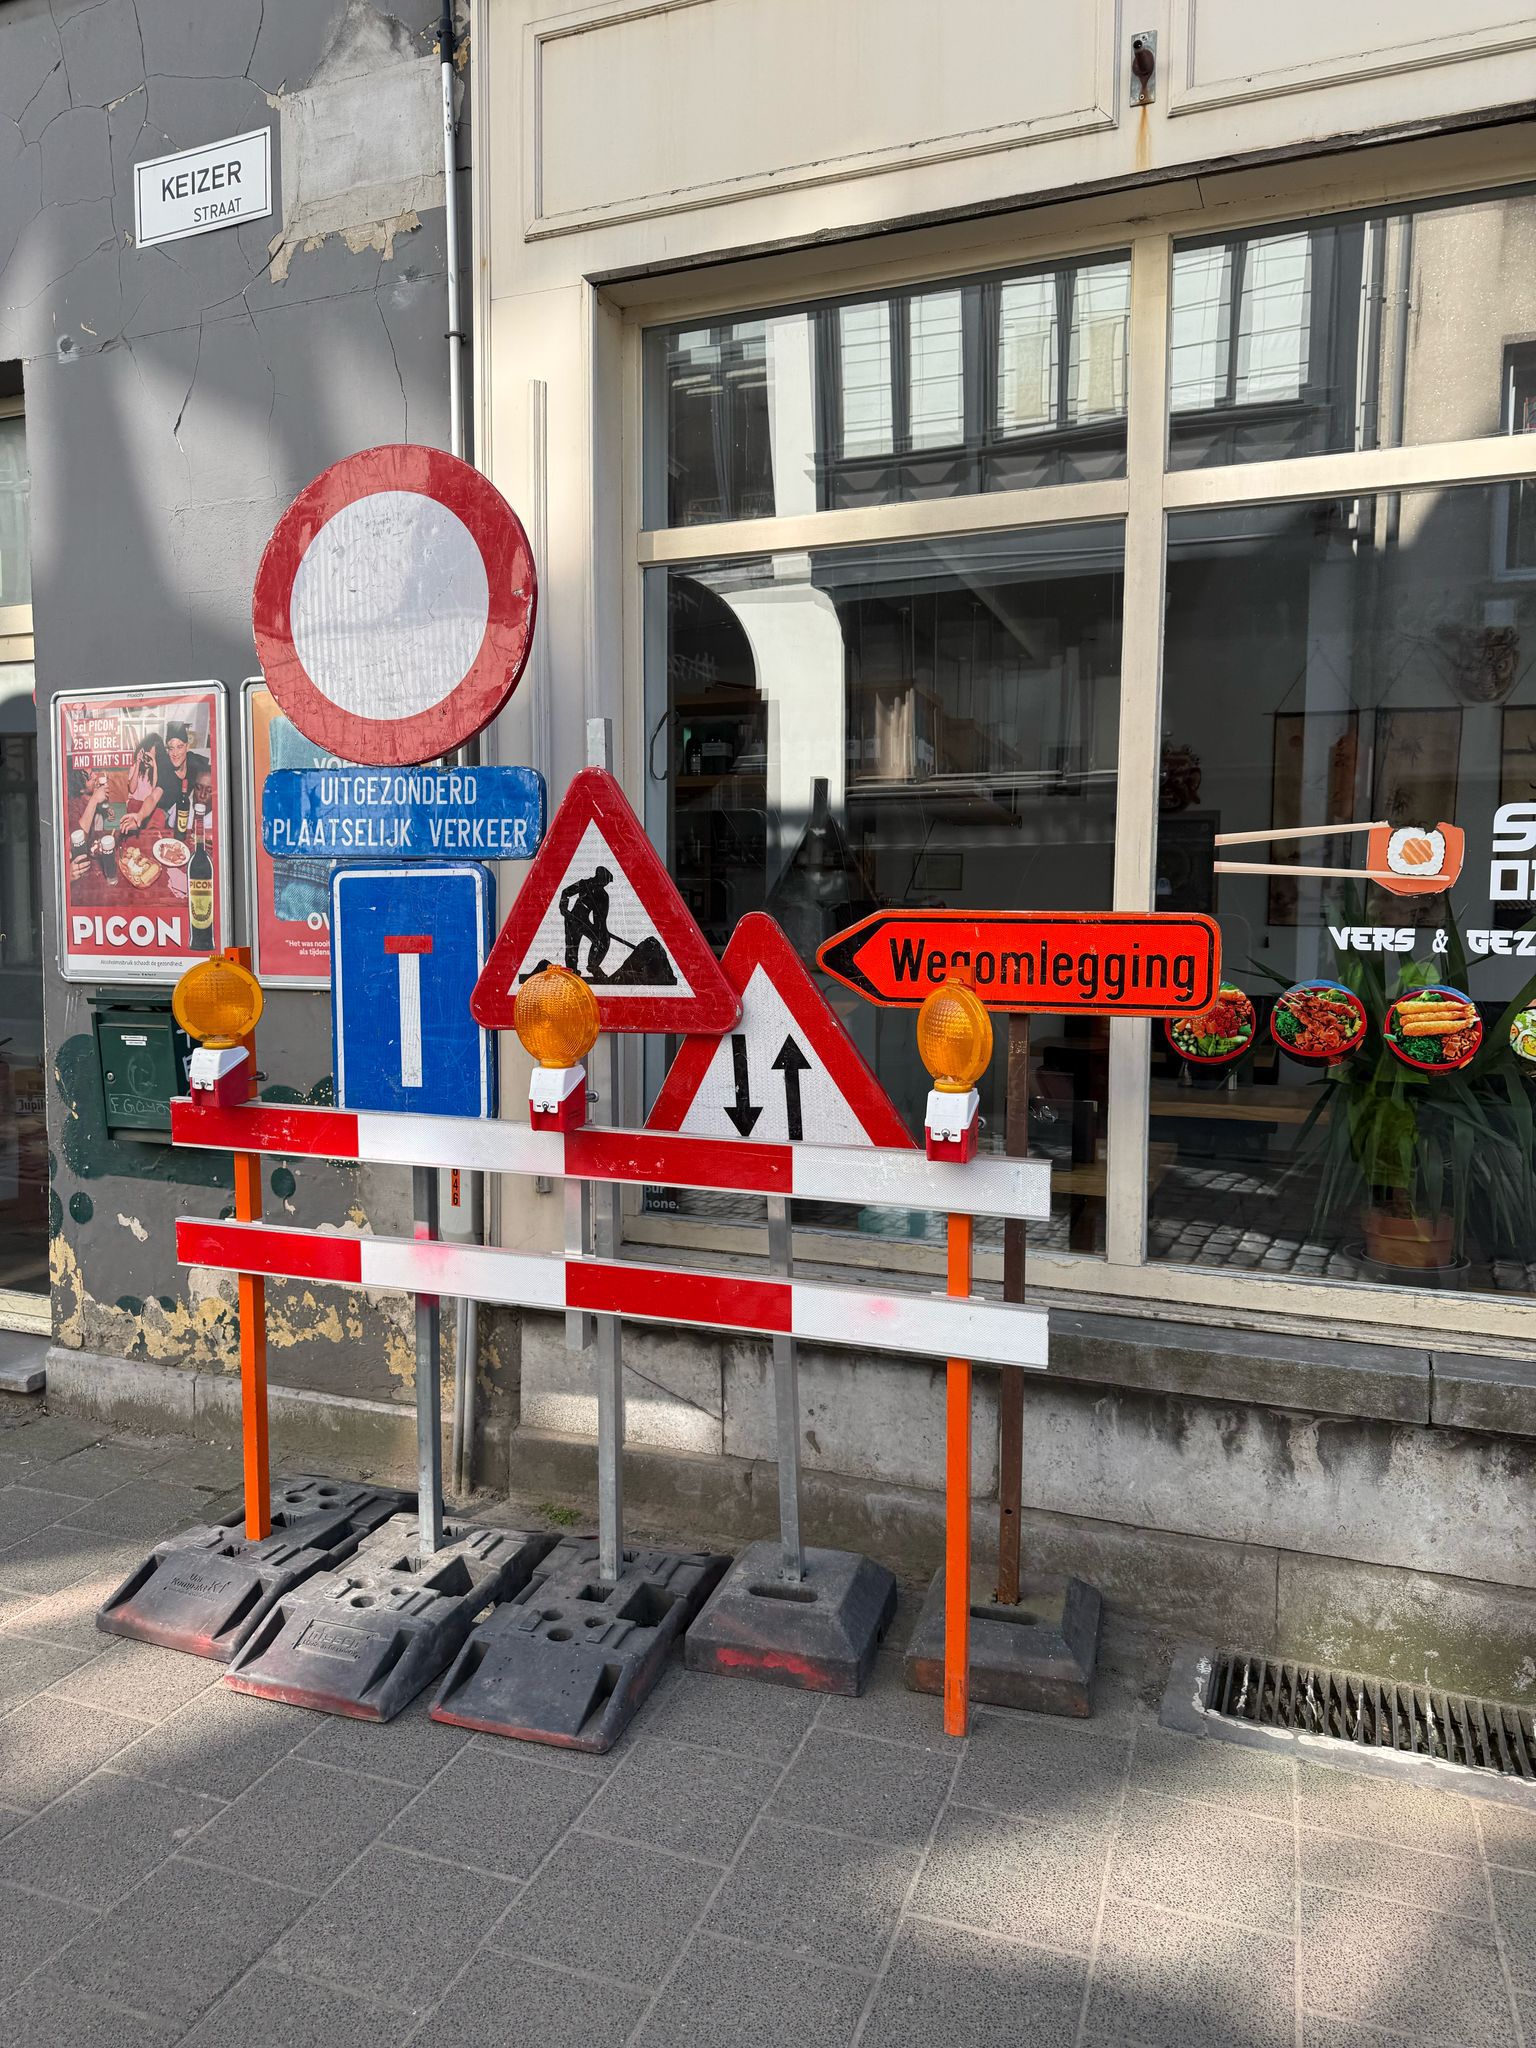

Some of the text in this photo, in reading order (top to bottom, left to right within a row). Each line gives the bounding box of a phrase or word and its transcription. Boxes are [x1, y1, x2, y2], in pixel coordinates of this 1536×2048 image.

[161, 160, 243, 202] KEIZER
[193, 197, 242, 223] STRAAT
[73, 719, 117, 733] 5cl PICON.
[73, 738, 91, 750] 25cl
[74, 753, 133, 768] AND THAT'S IT!
[320, 776, 477, 806] UITGEZONDERD
[272, 818, 528, 848] PLAATSELIJK VERKEER
[1489, 859, 1536, 901] O
[72, 915, 182, 947] PICON
[1328, 926, 1415, 952] VERS
[1432, 928, 1449, 953] &
[18, 1098, 45, 1113] Jupil
